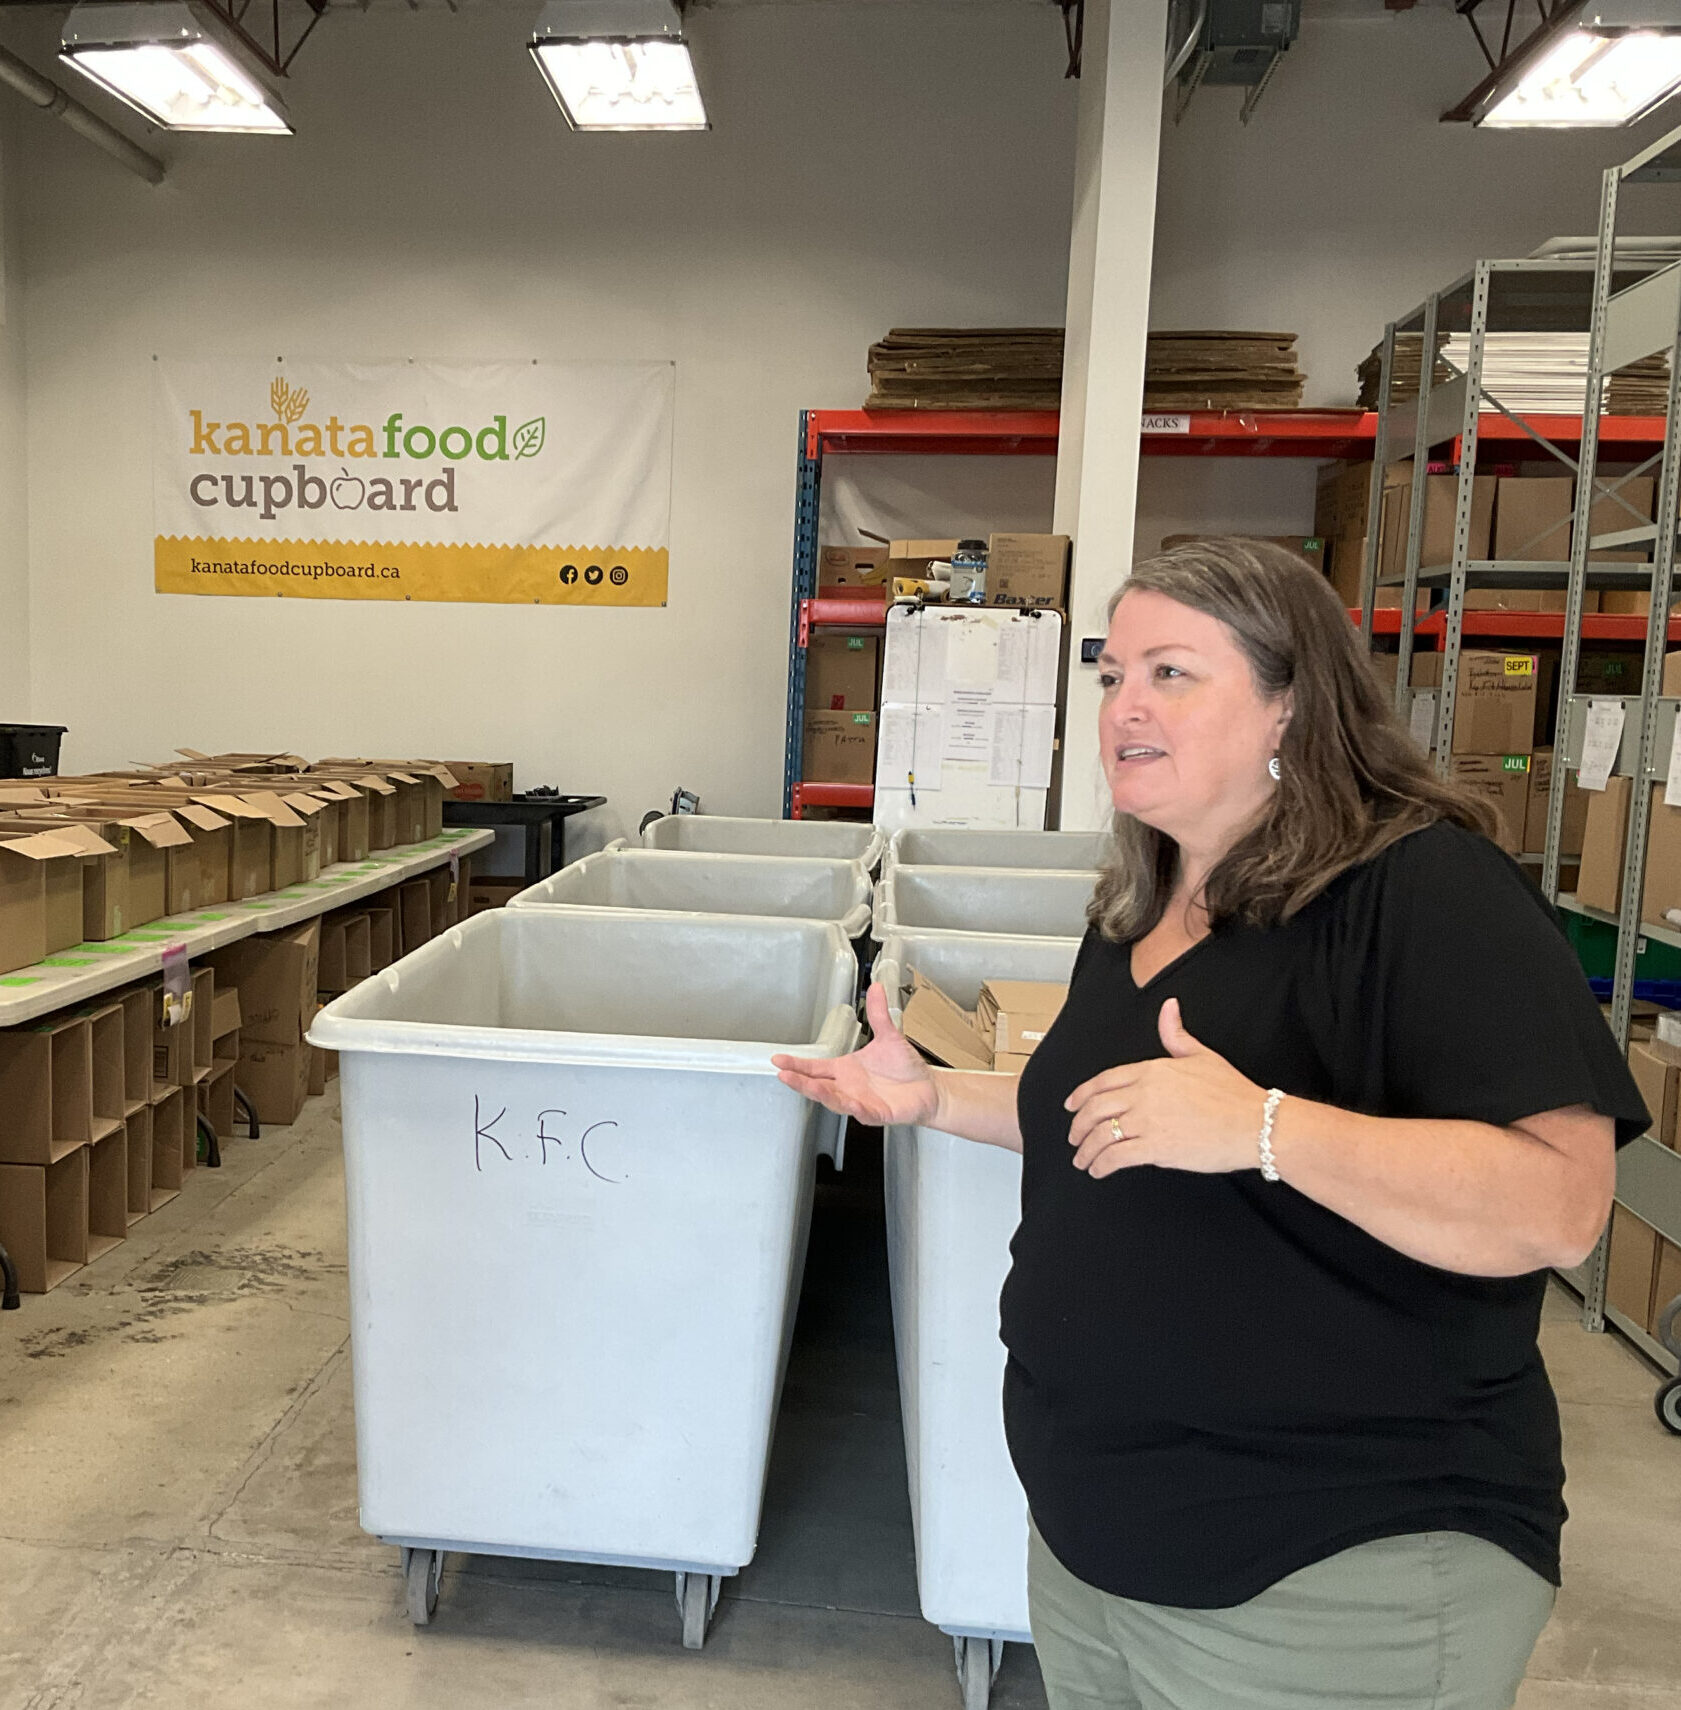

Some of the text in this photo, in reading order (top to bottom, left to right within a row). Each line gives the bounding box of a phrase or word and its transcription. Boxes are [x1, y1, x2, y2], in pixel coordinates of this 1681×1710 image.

[190, 558, 401, 580] kanatafoodcupboard.ca
[848, 637, 864, 647] JUL
[1506, 660, 1530, 671] SEPT
[854, 713, 870, 723] JUL
[1504, 758, 1526, 770] JUL
